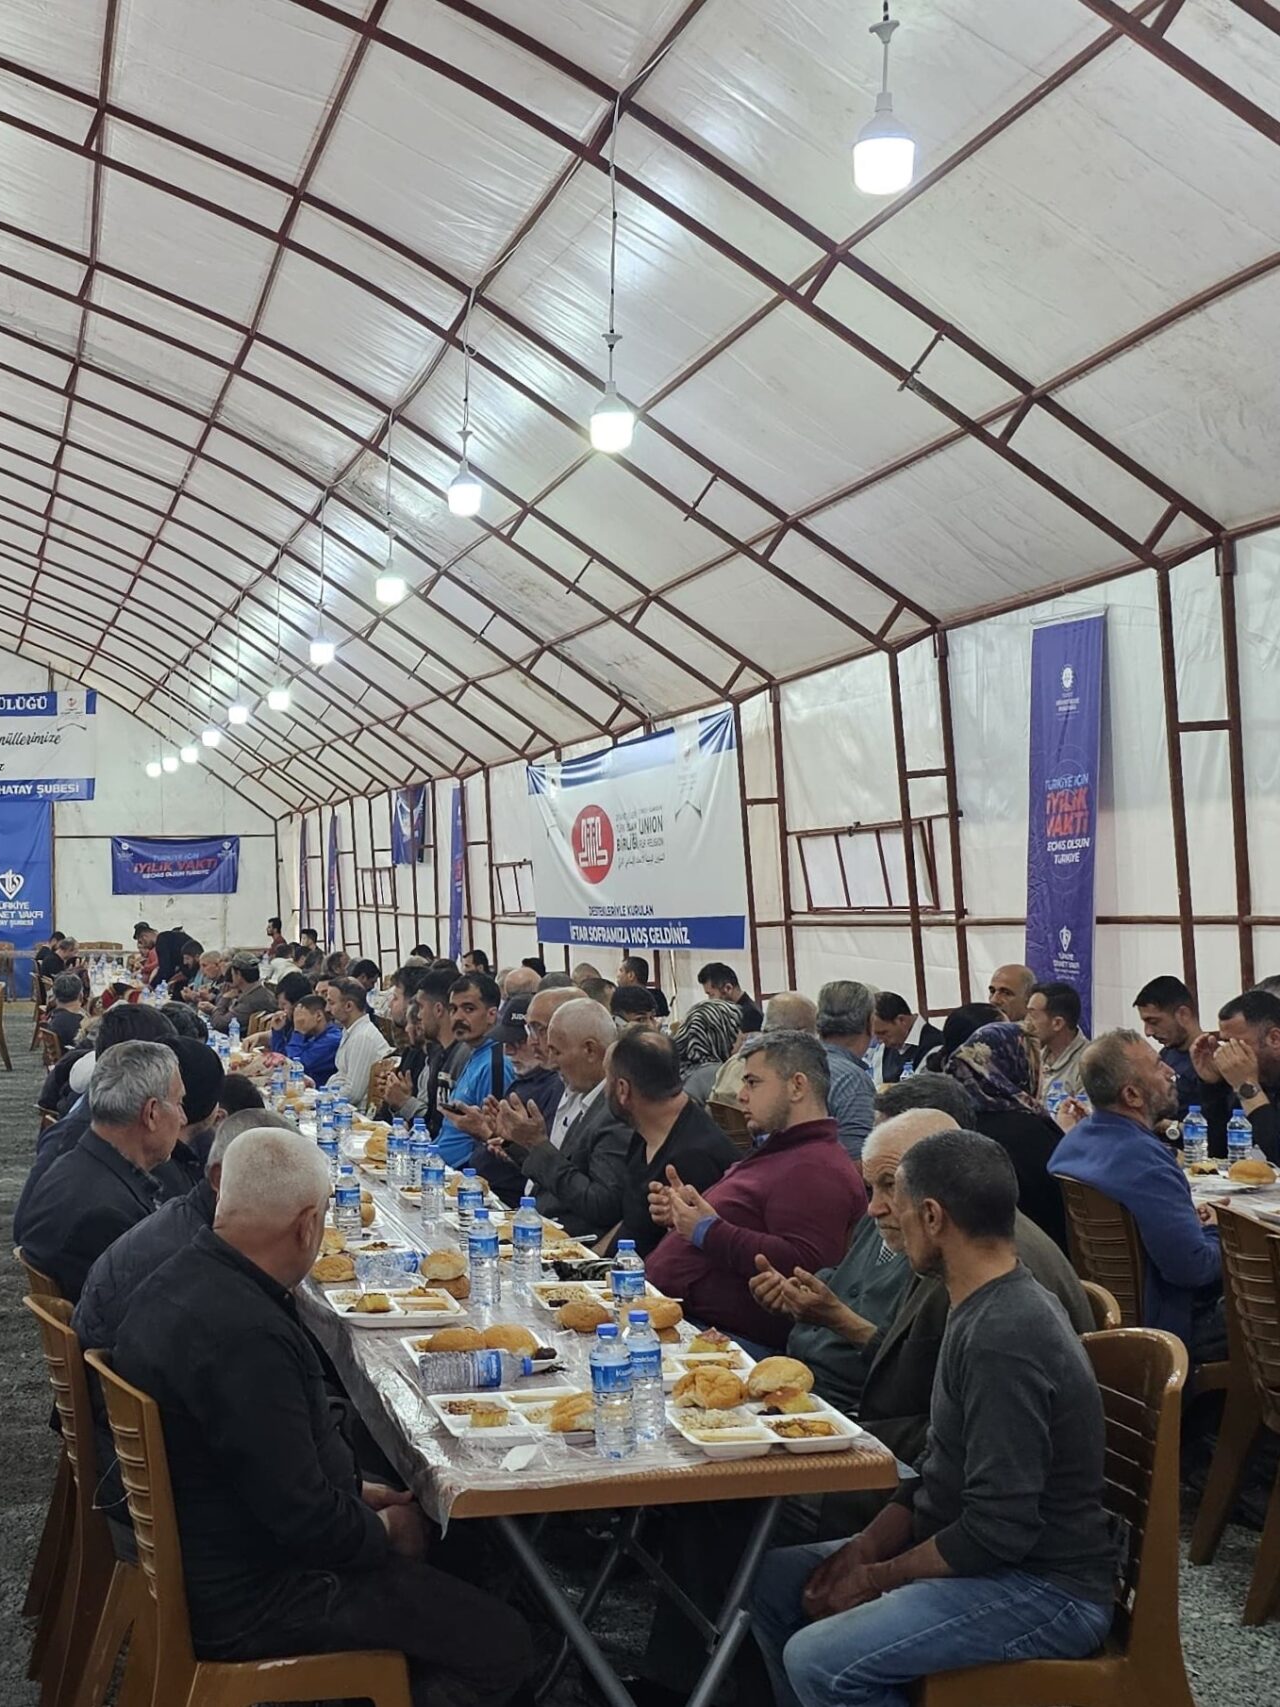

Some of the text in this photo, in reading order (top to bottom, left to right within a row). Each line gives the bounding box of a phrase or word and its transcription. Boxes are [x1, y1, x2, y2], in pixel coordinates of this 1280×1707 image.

[36, 783, 80, 798] ŞUBESİ
[638, 814, 663, 835] UNION
[630, 927, 648, 948] HOŞ
[649, 921, 691, 944] GELDİNİZ
